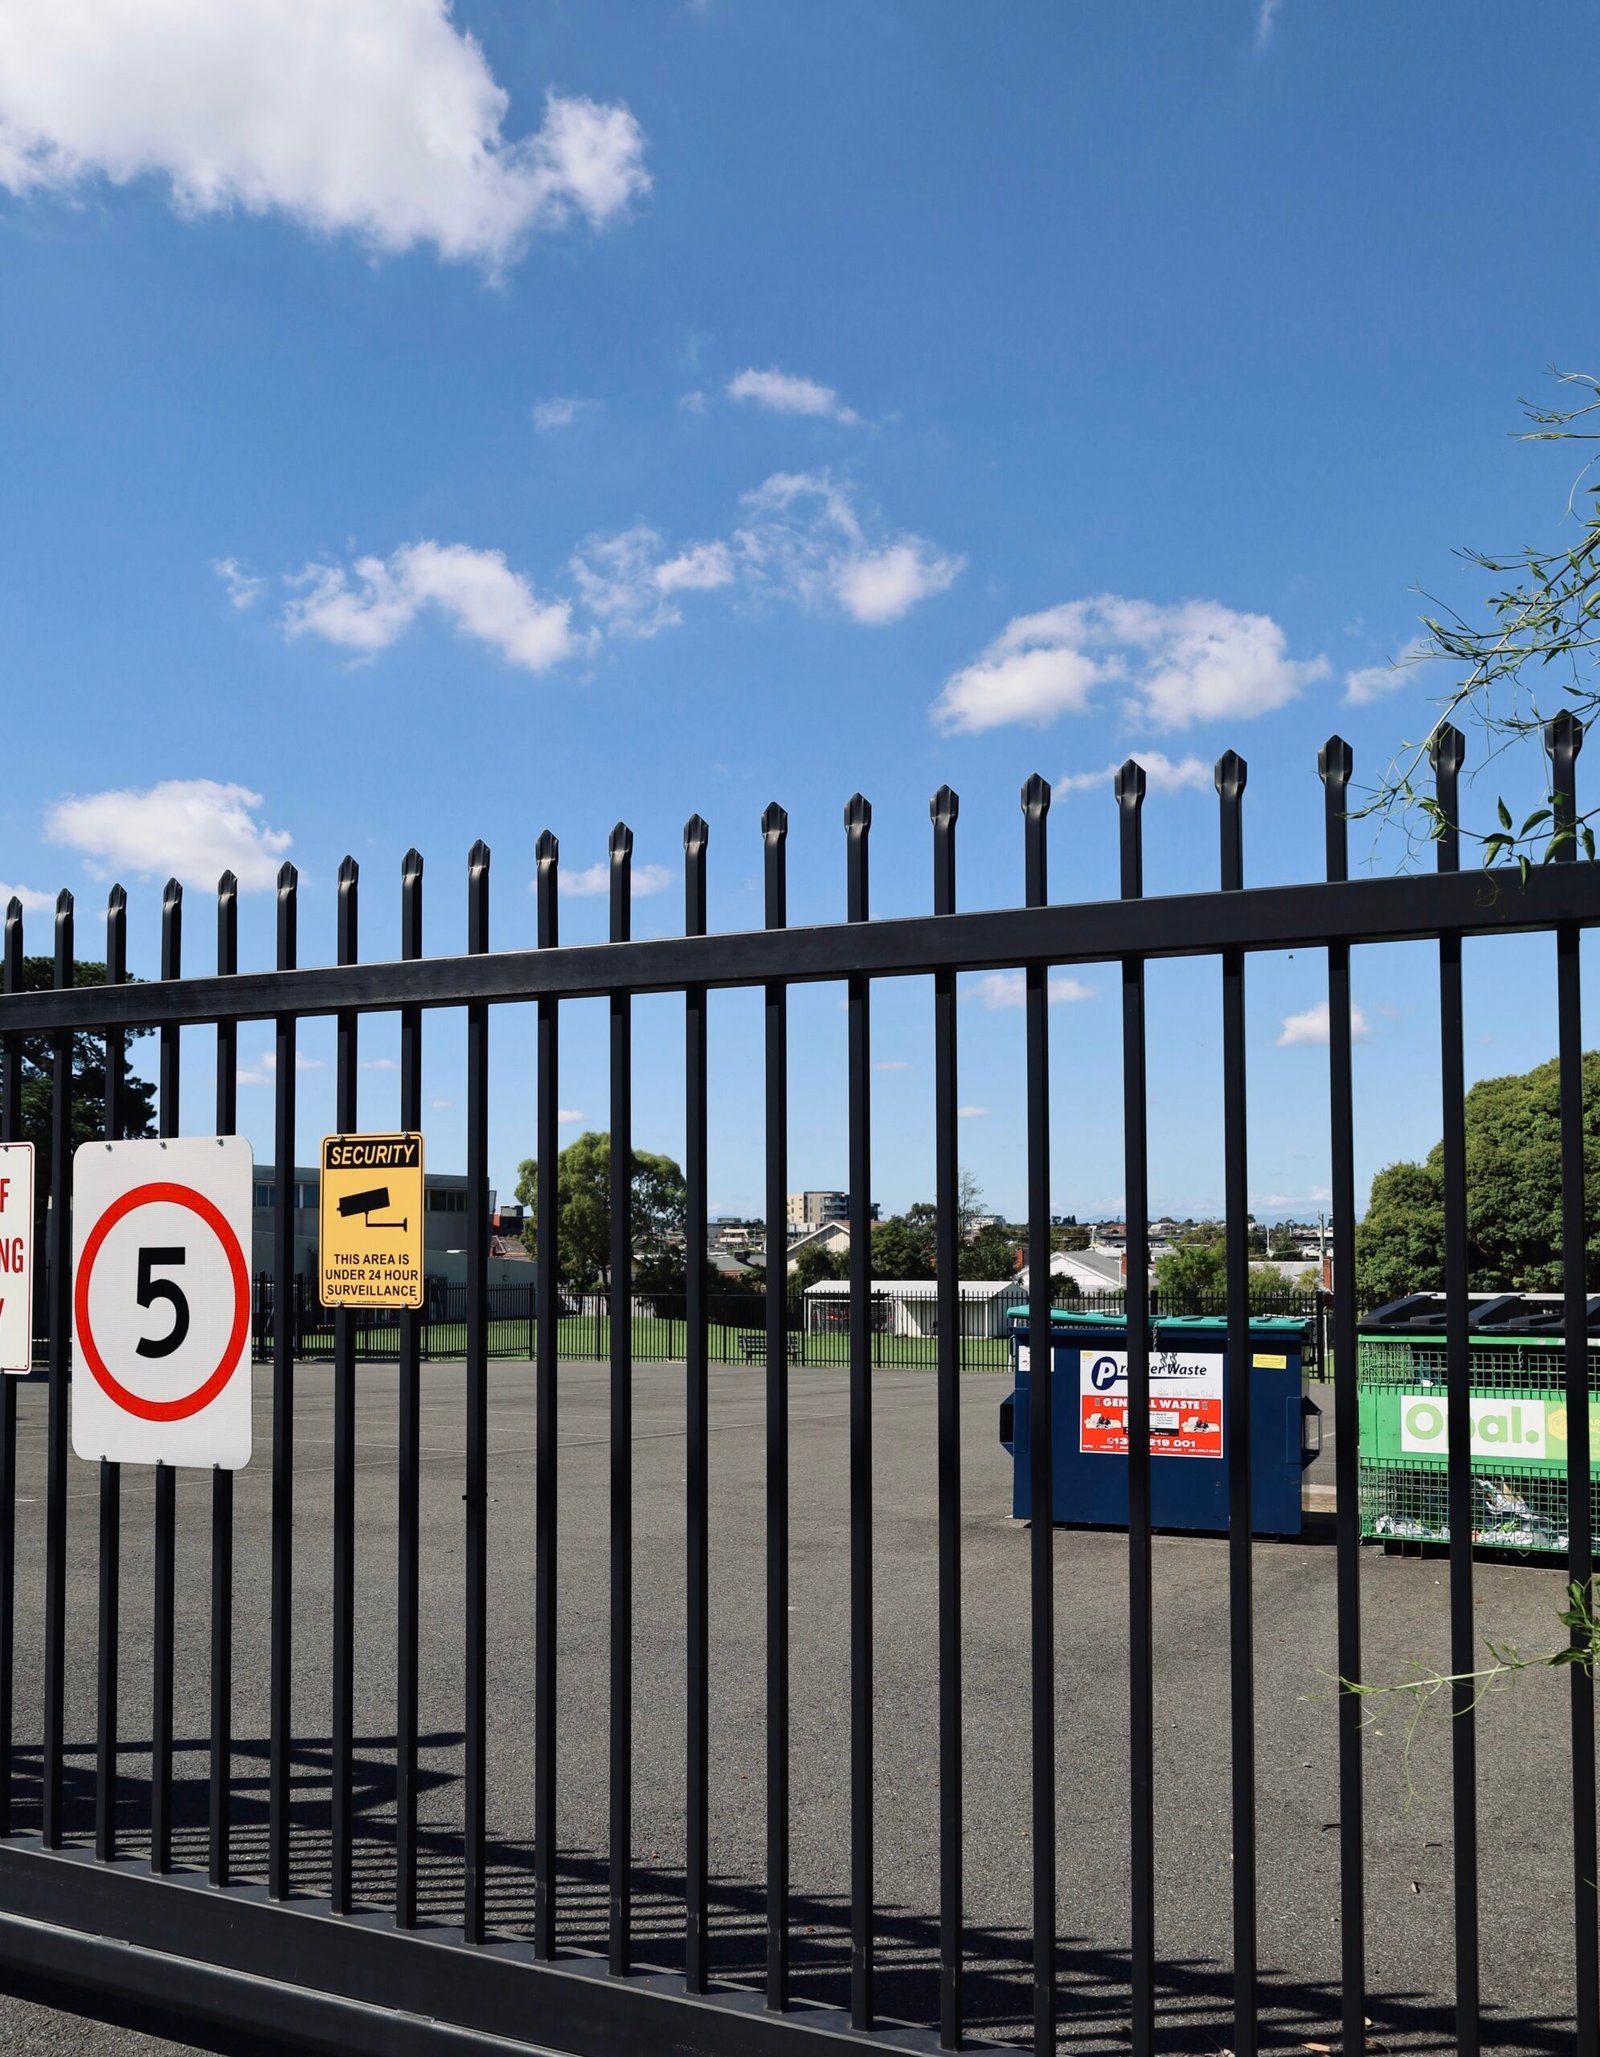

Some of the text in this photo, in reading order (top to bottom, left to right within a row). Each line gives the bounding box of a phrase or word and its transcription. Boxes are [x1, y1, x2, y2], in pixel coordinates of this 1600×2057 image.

[331, 1144, 415, 1165] SECURITY
[334, 1254, 410, 1265] THIS AREA IS
[326, 1269, 418, 1280] UNDER 24 HOUR
[327, 1284, 416, 1296] SURVEILLANCE
[135, 1246, 190, 1359] 5
[1167, 1362, 1207, 1376] Waste
[1102, 1398, 1200, 1410] GENL WASTE
[1406, 1403, 1539, 1444] Oal.
[1149, 1438, 1170, 1446] 219
